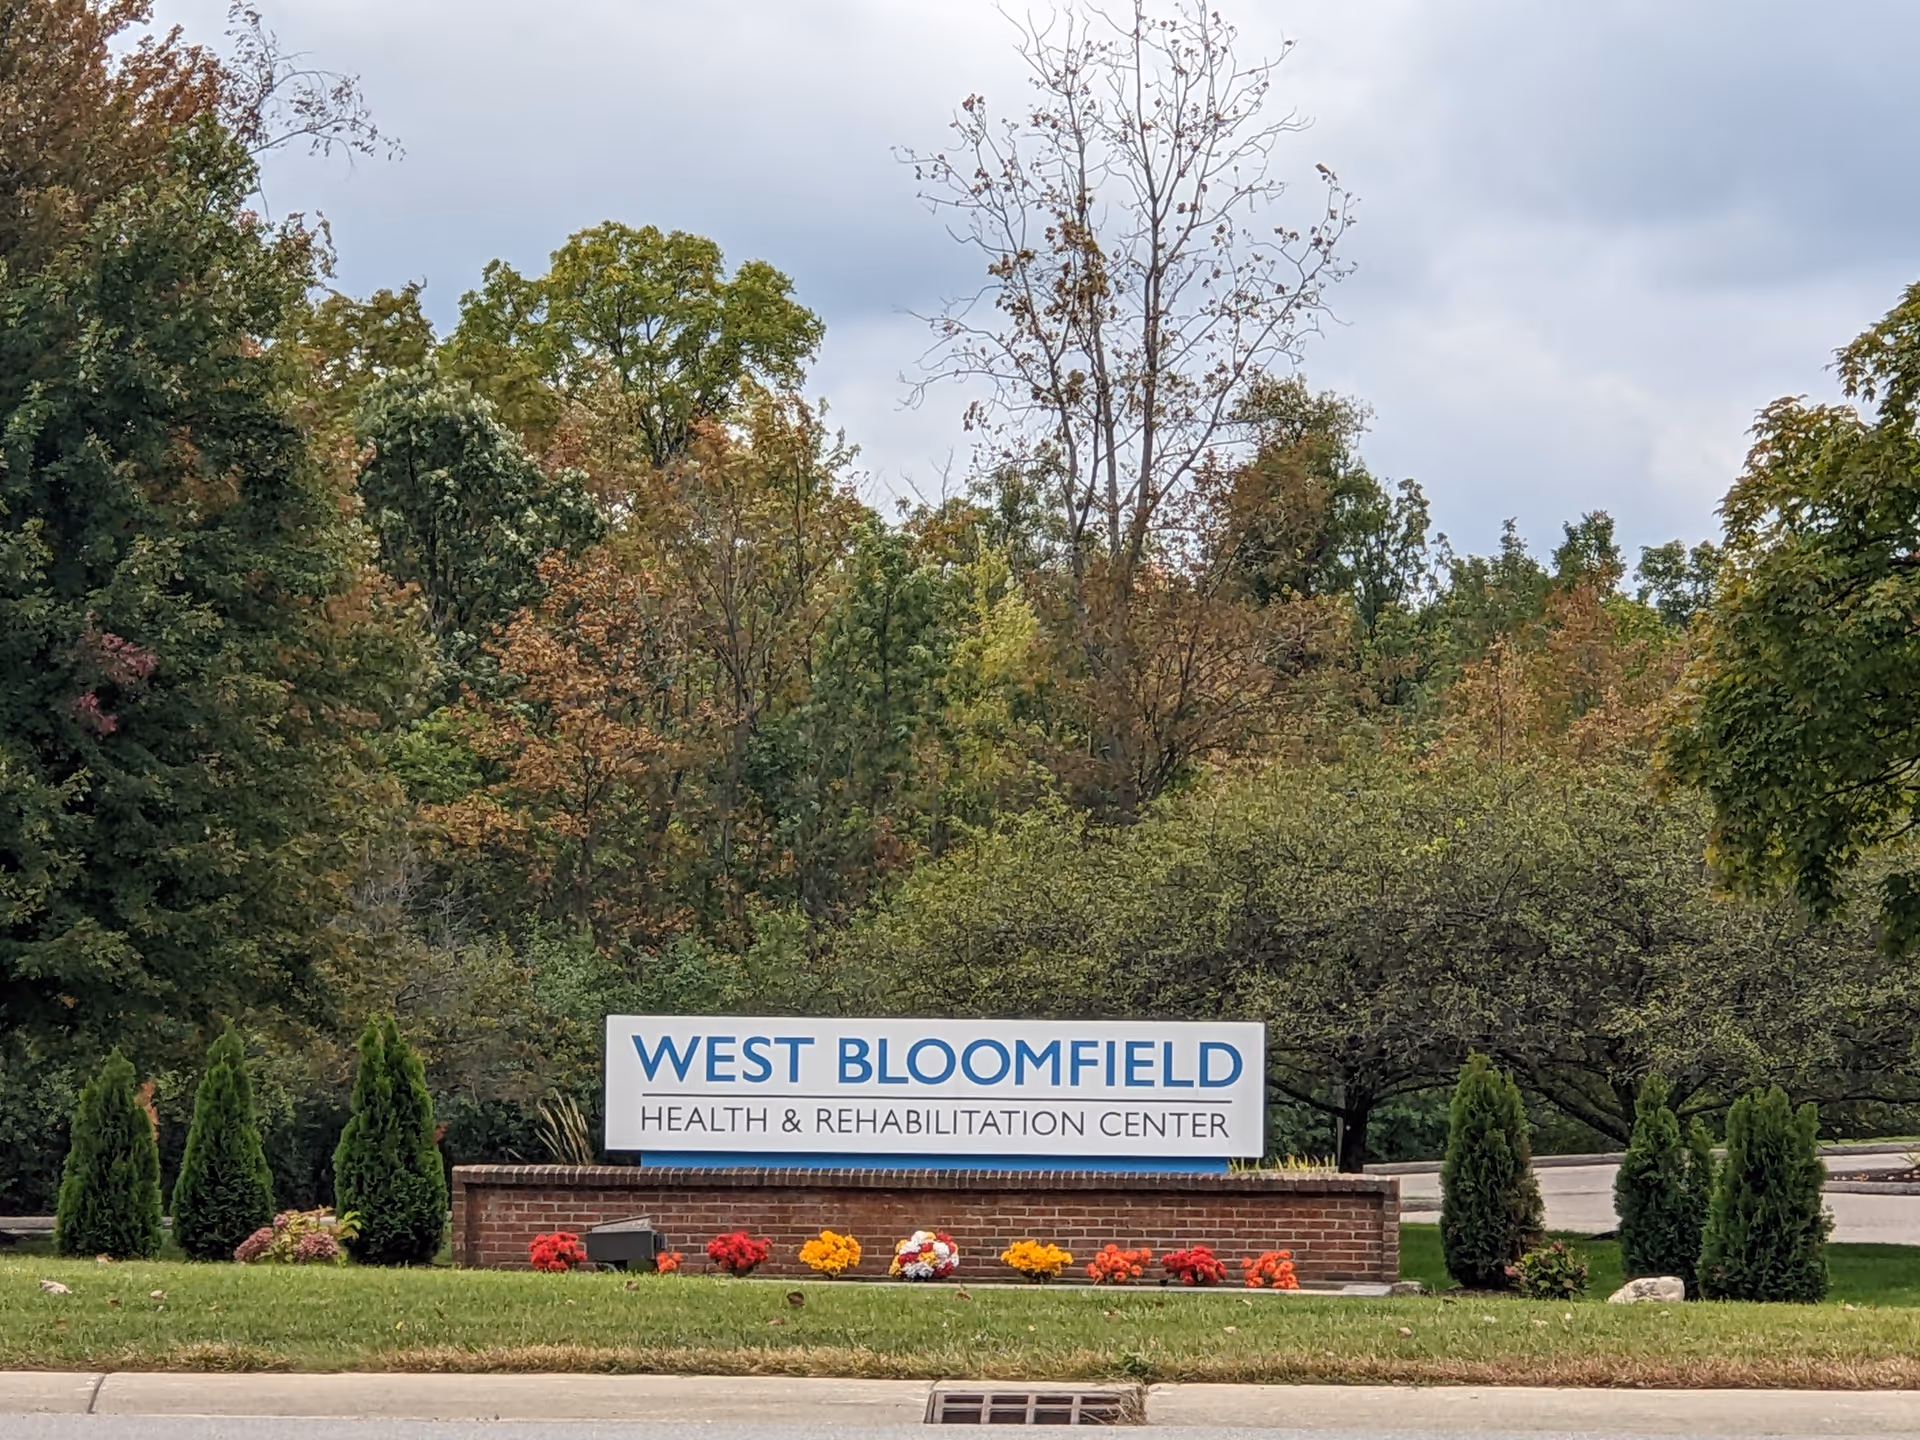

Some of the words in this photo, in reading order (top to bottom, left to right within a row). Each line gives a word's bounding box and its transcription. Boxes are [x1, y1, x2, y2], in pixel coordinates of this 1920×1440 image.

[631, 1034, 815, 1083] WEST
[838, 1037, 1244, 1088] BLOOMFIELD
[641, 1105, 767, 1133] HEALTH
[781, 1108, 803, 1133] &
[816, 1108, 1084, 1136] REHABILITATION
[1099, 1111, 1230, 1138] CENTER
